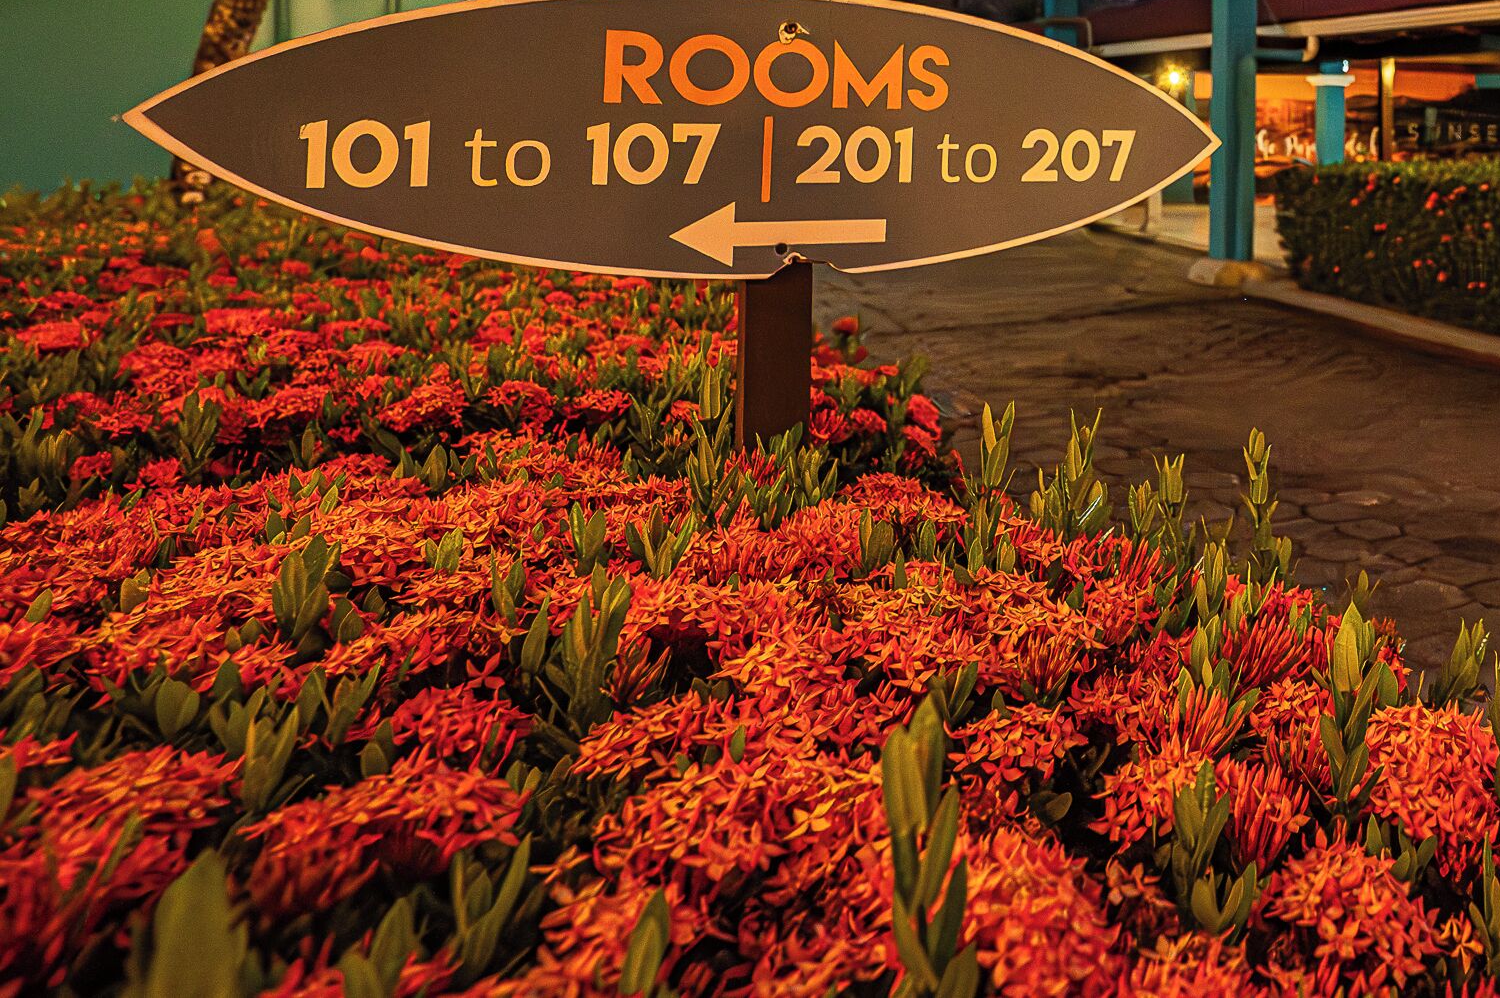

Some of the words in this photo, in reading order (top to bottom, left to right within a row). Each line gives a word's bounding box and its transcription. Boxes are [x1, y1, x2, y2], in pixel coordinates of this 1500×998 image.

[603, 29, 950, 111] ROOMS
[299, 119, 431, 189] 101
[465, 128, 551, 186] to
[586, 122, 722, 186] 107
[795, 125, 914, 184] 201
[937, 133, 997, 183] to
[1021, 128, 1137, 183] 207
